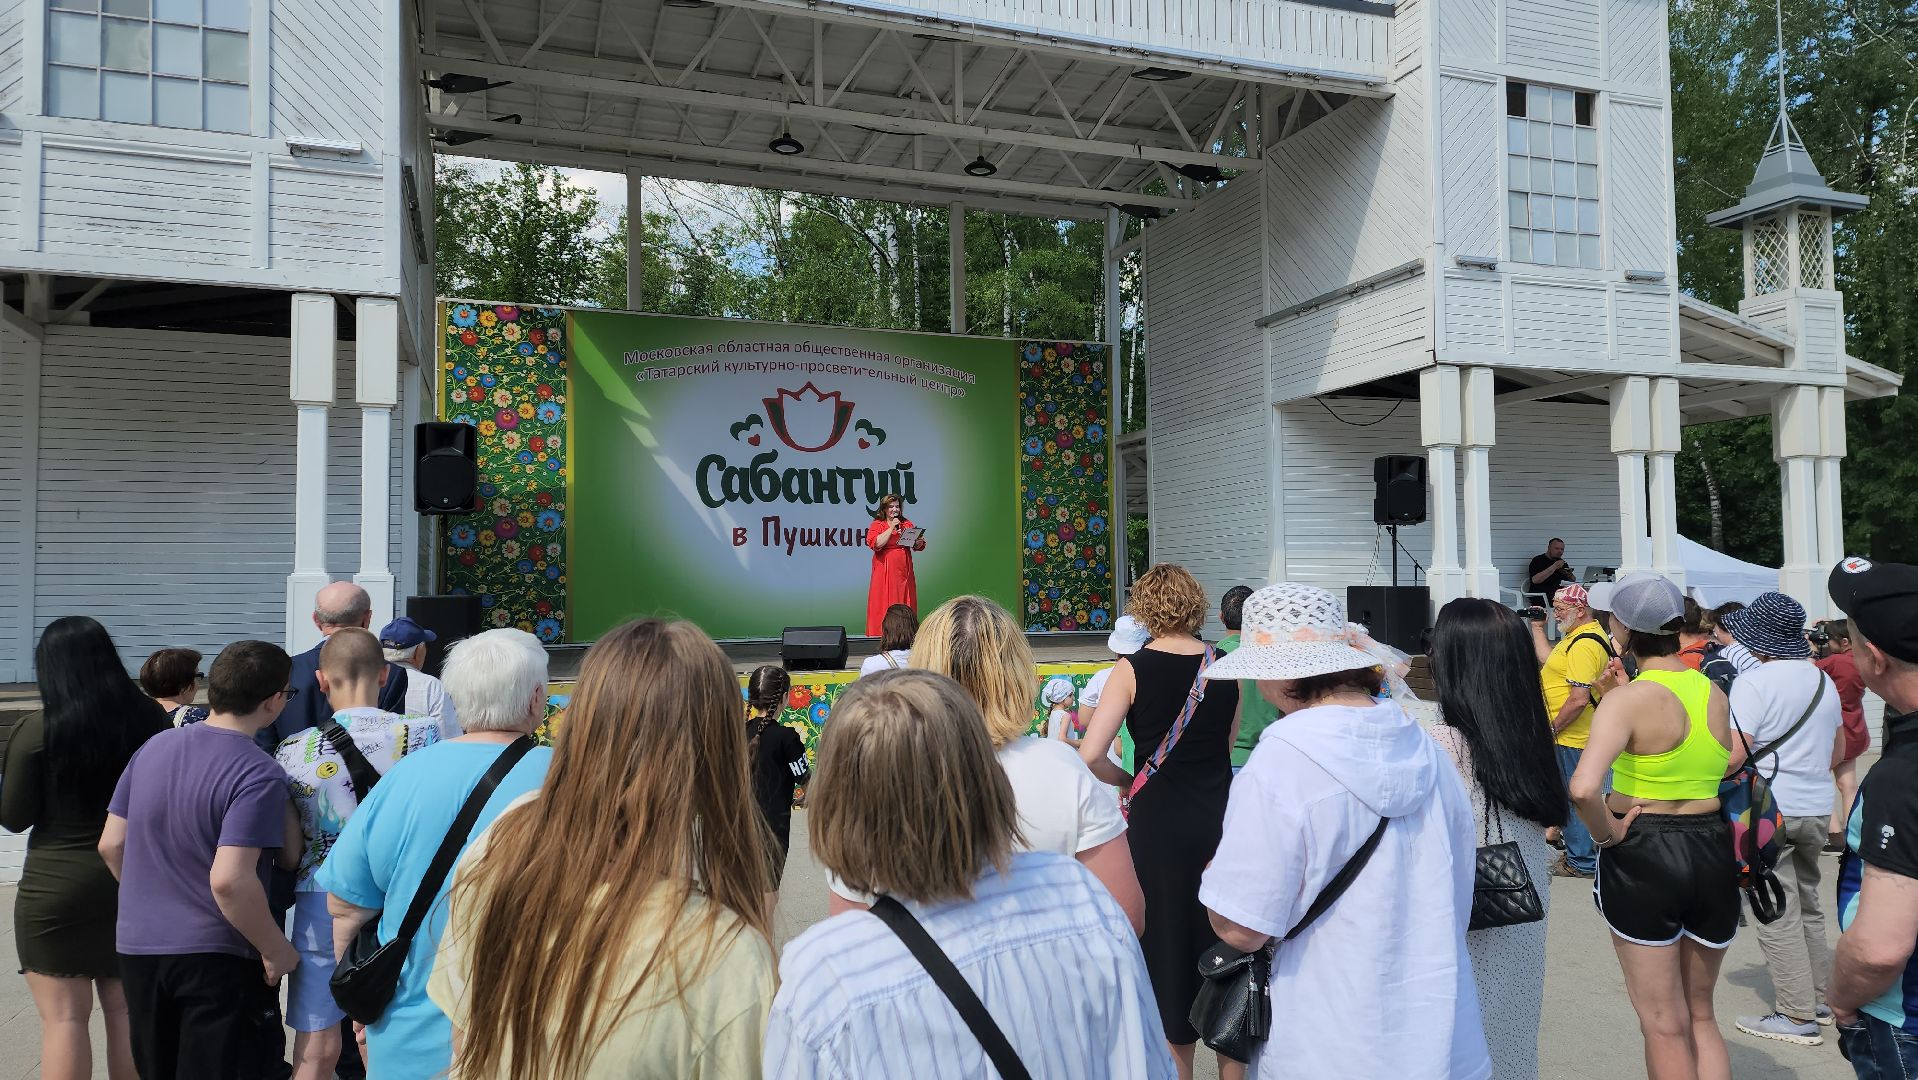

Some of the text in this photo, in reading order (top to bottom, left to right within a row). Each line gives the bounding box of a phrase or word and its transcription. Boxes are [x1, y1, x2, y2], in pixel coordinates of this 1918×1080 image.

[624, 340, 976, 385] Московская областная общественная организация
[636, 360, 720, 381] «Татарский
[921, 377, 965, 397] центр»
[695, 448, 918, 519] Сабантуй
[732, 515, 870, 556] в Пушкин
